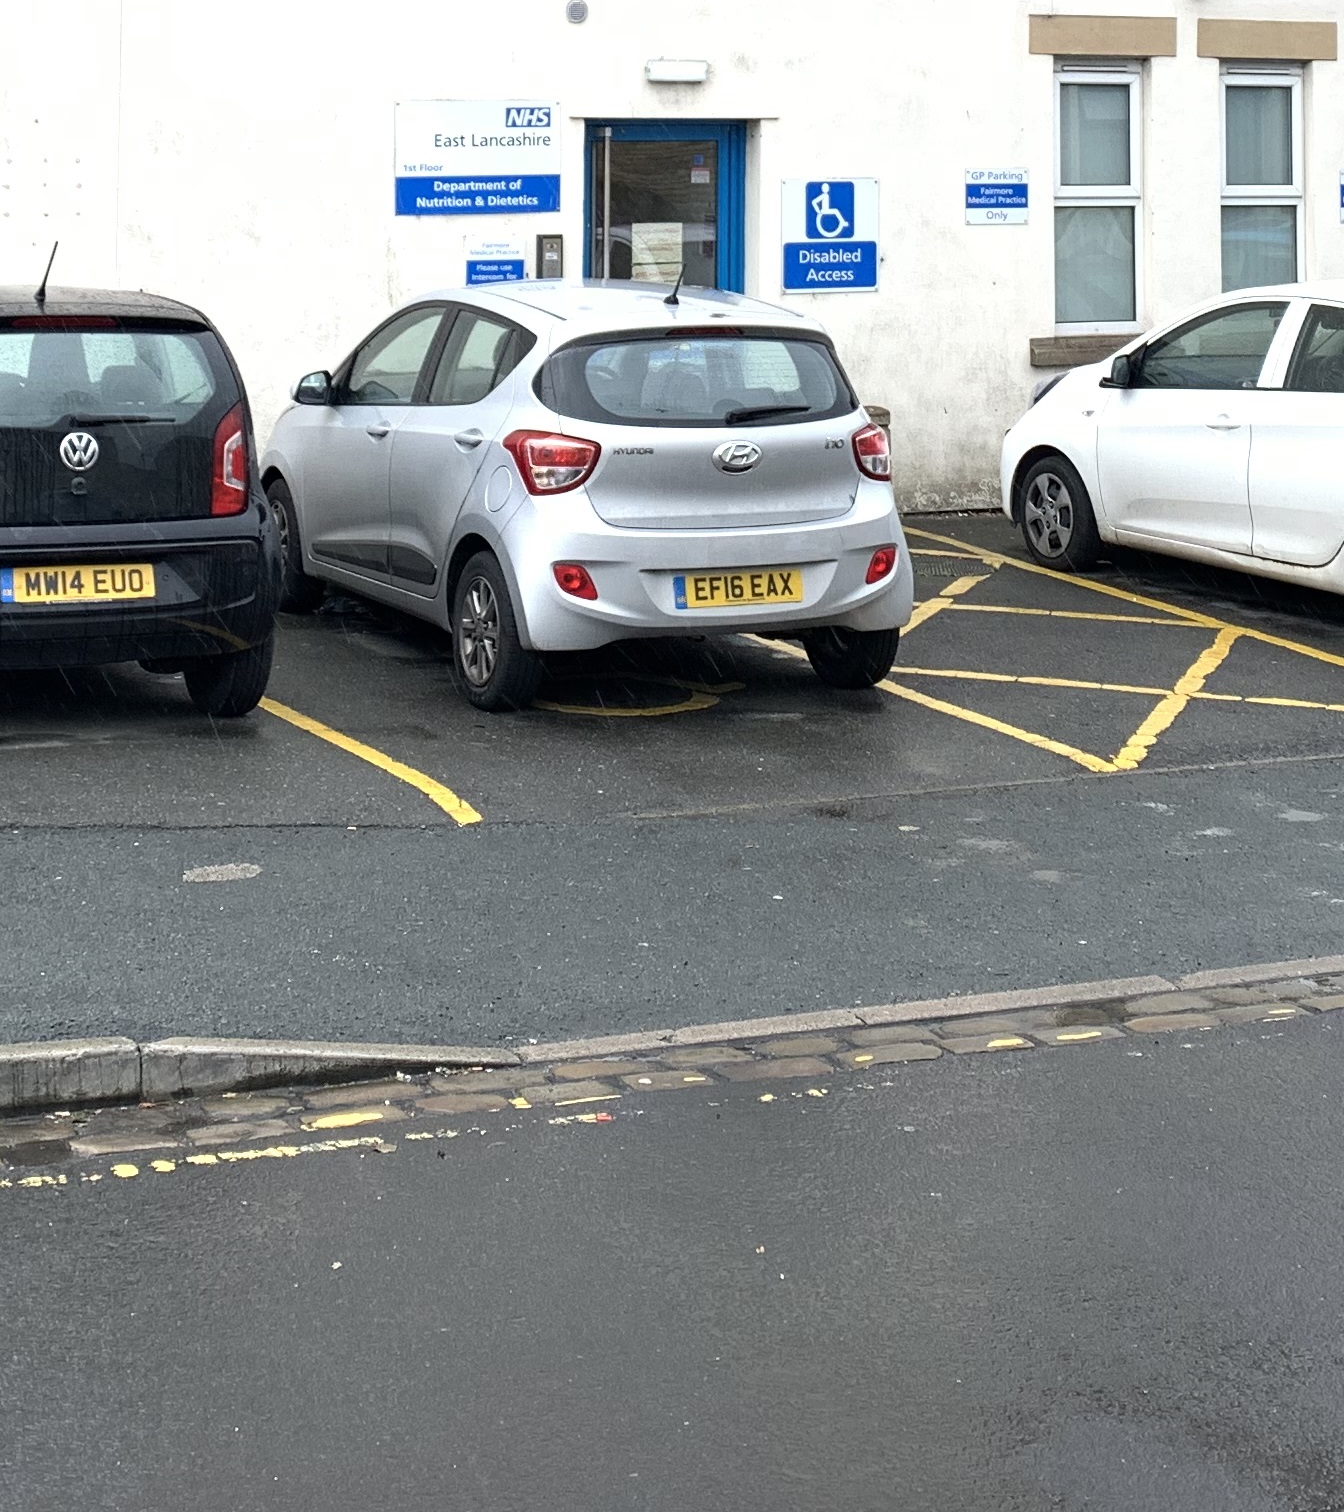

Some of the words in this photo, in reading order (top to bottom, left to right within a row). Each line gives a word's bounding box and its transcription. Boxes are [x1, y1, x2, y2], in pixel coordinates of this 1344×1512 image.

[506, 108, 550, 127] NHS
[434, 133, 466, 147] East
[471, 132, 551, 147] Lancashire
[403, 164, 417, 172] 1st
[419, 163, 444, 172] Floor
[971, 171, 985, 180] GP
[987, 171, 1023, 182] Parking
[433, 180, 506, 193] Department
[509, 179, 522, 190] of
[416, 196, 471, 208] Nutrition
[474, 196, 485, 206] &
[487, 194, 538, 206] Dietetics
[986, 210, 1008, 221] Only
[799, 248, 861, 264] Disabled
[806, 268, 854, 282] Access
[24, 570, 85, 597] MW14
[93, 568, 144, 594] EUO
[693, 575, 744, 601] EF16
[750, 572, 794, 597] EAX
